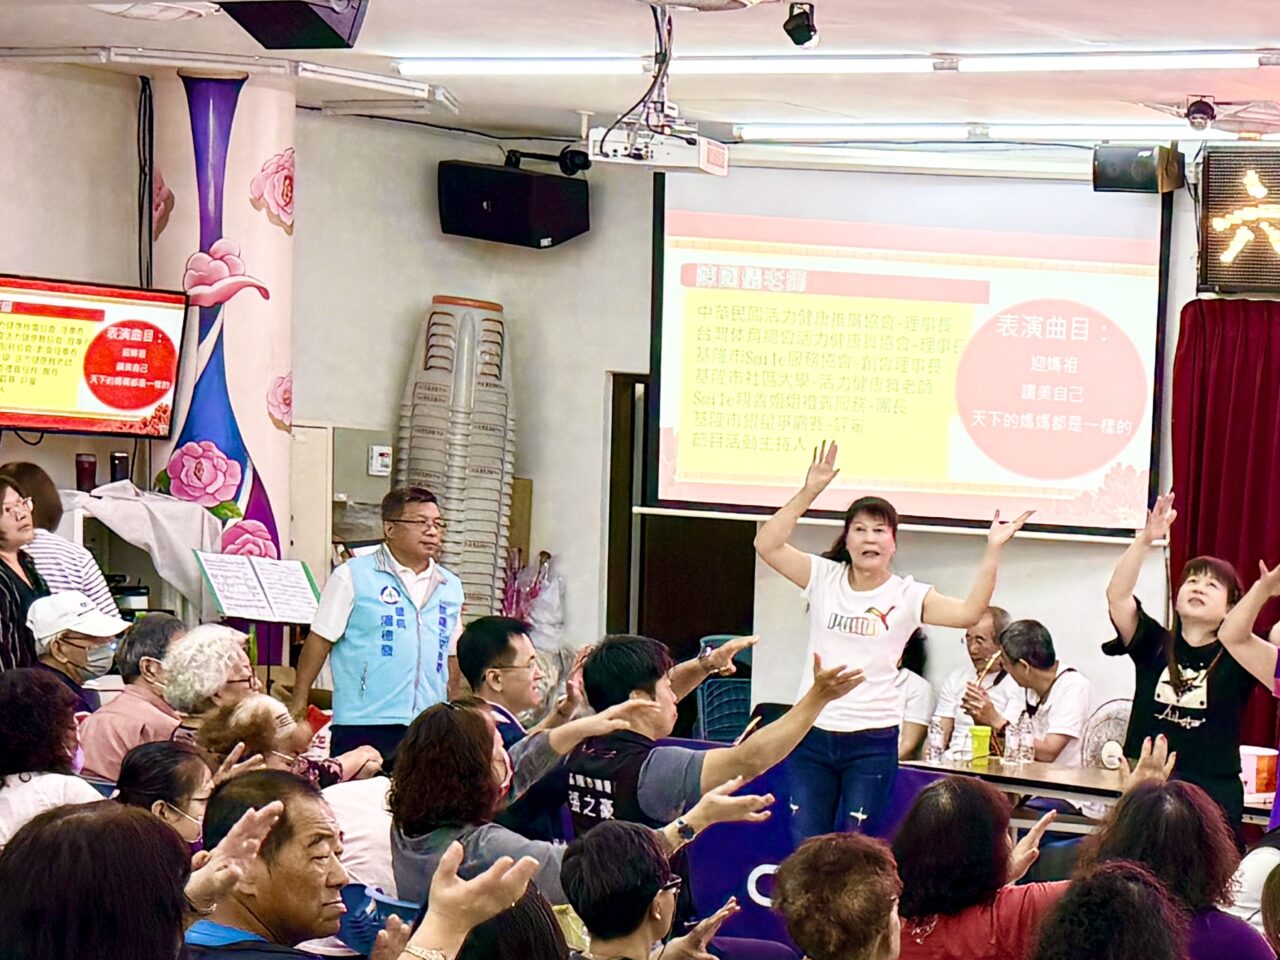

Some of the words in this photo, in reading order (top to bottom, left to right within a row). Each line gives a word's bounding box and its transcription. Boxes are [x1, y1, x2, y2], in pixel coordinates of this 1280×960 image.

[1030, 355, 1078, 373] 迎媽祖
[972, 409, 1133, 436] 天下的媽媽都是一樣的
